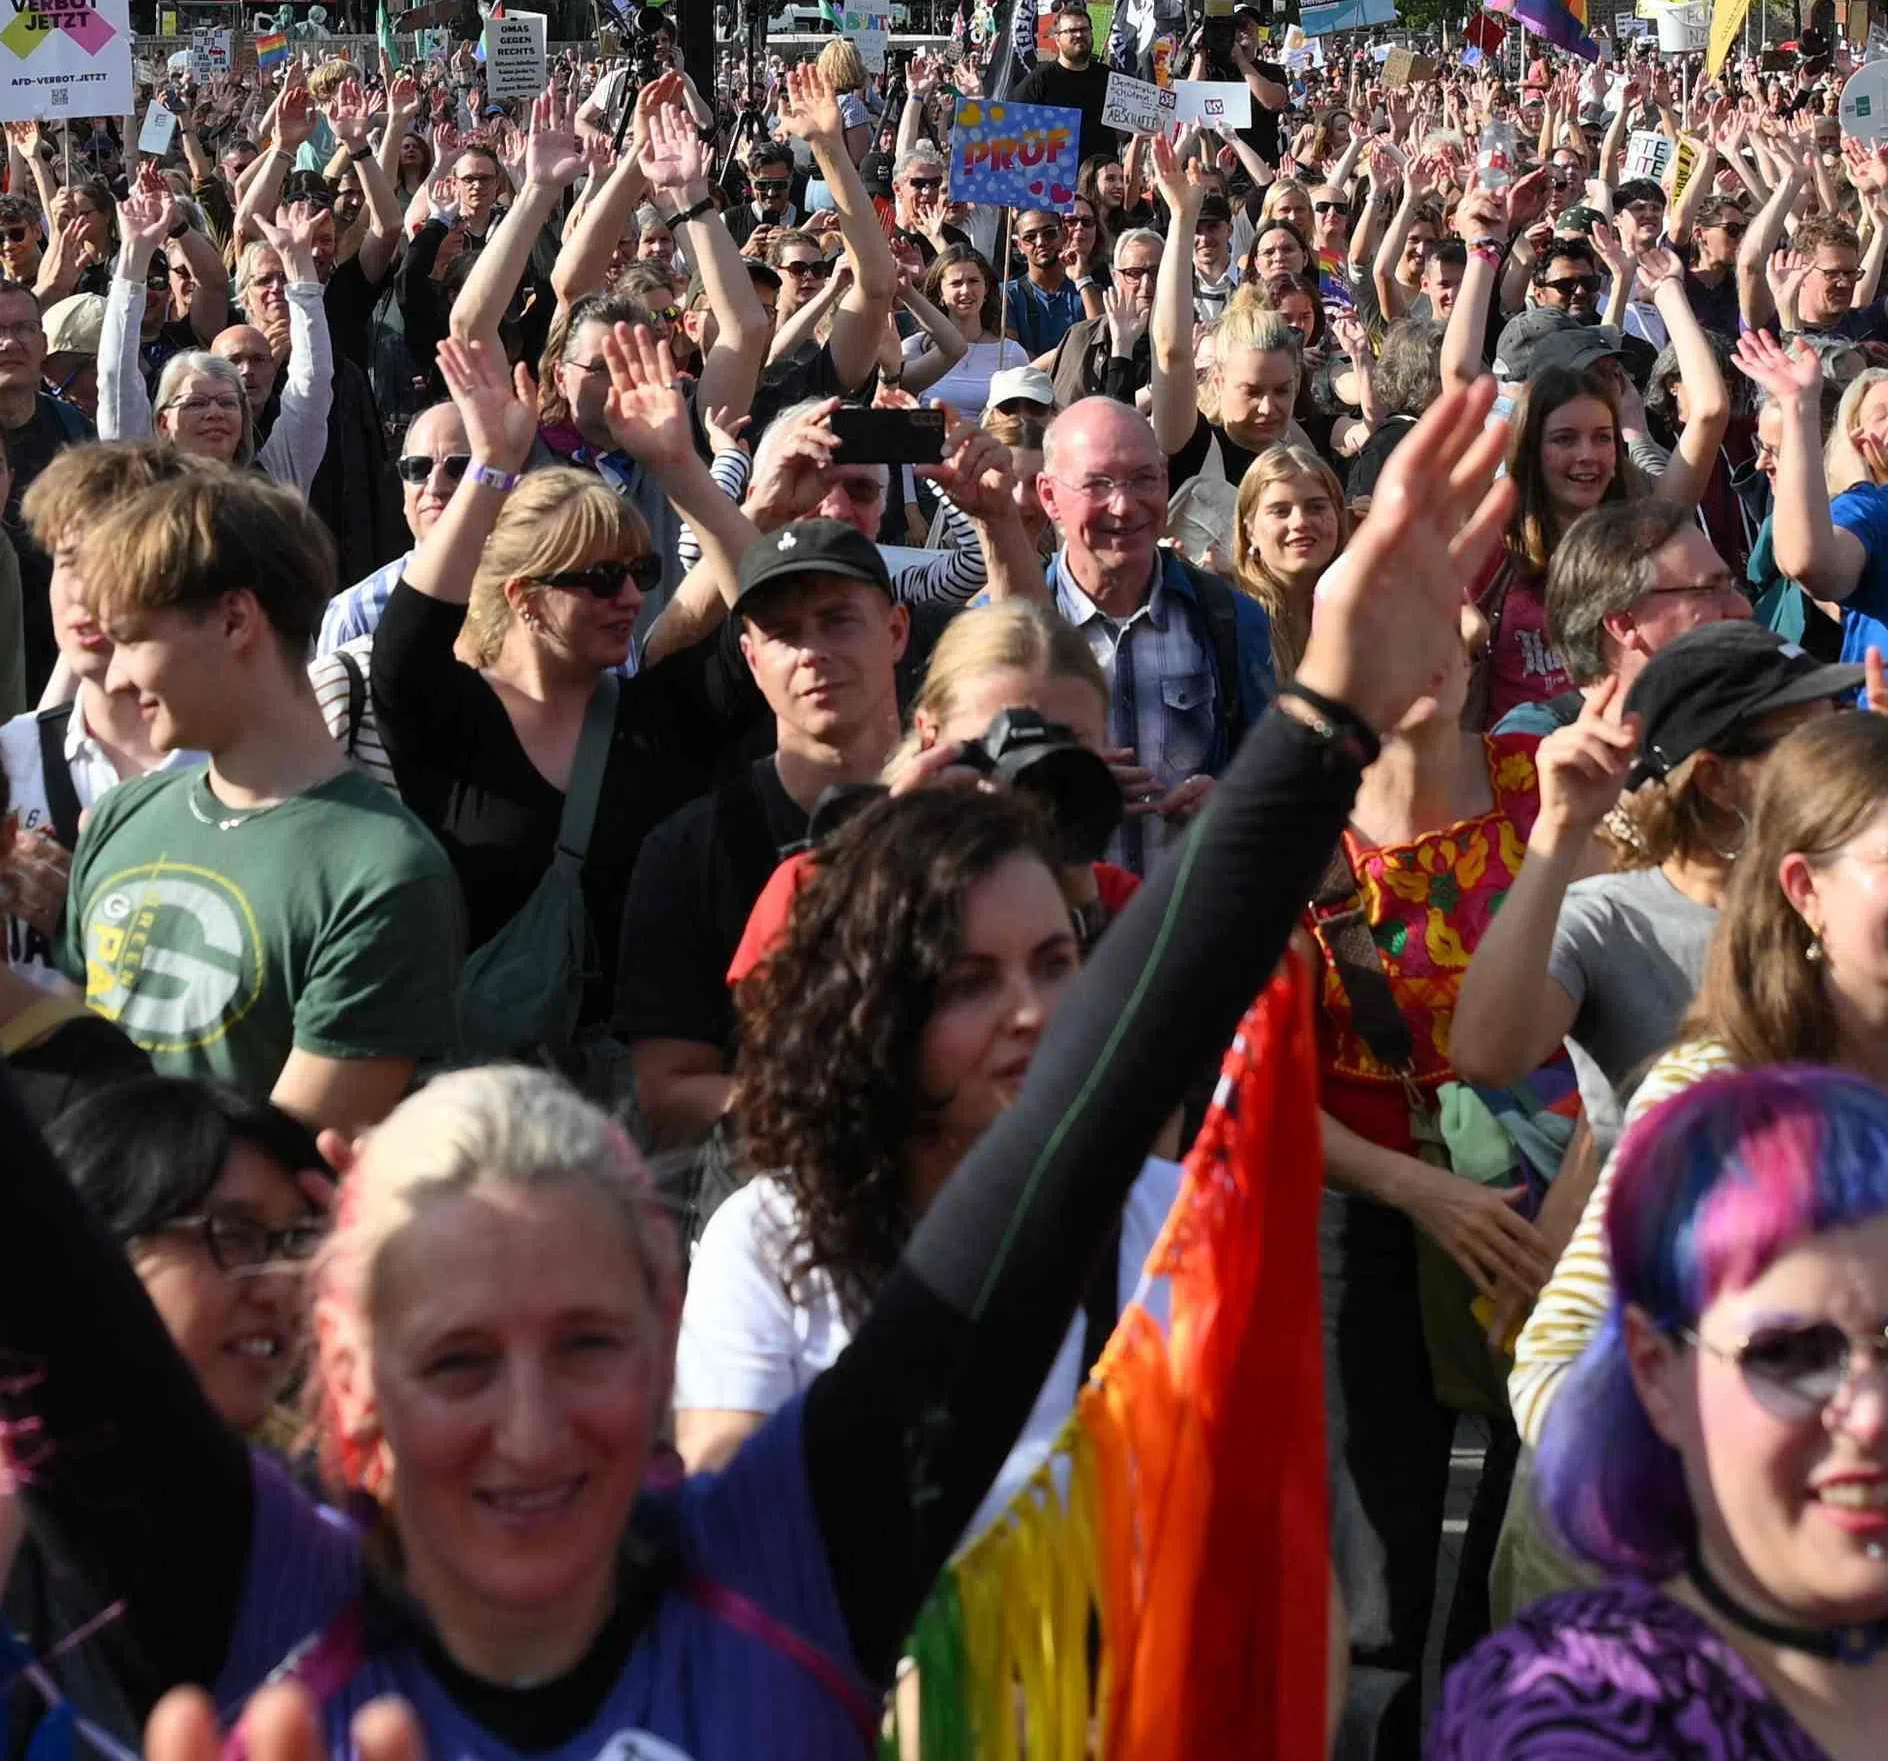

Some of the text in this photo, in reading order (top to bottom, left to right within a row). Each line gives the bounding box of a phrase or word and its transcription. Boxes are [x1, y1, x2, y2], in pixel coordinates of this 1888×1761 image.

[25, 11, 92, 31] JETZT
[500, 24, 530, 33] OMAS
[499, 36, 532, 45] GEGEN
[497, 46, 536, 56] RECHTS
[10, 72, 108, 87] AFD-VERBOT.JETZT
